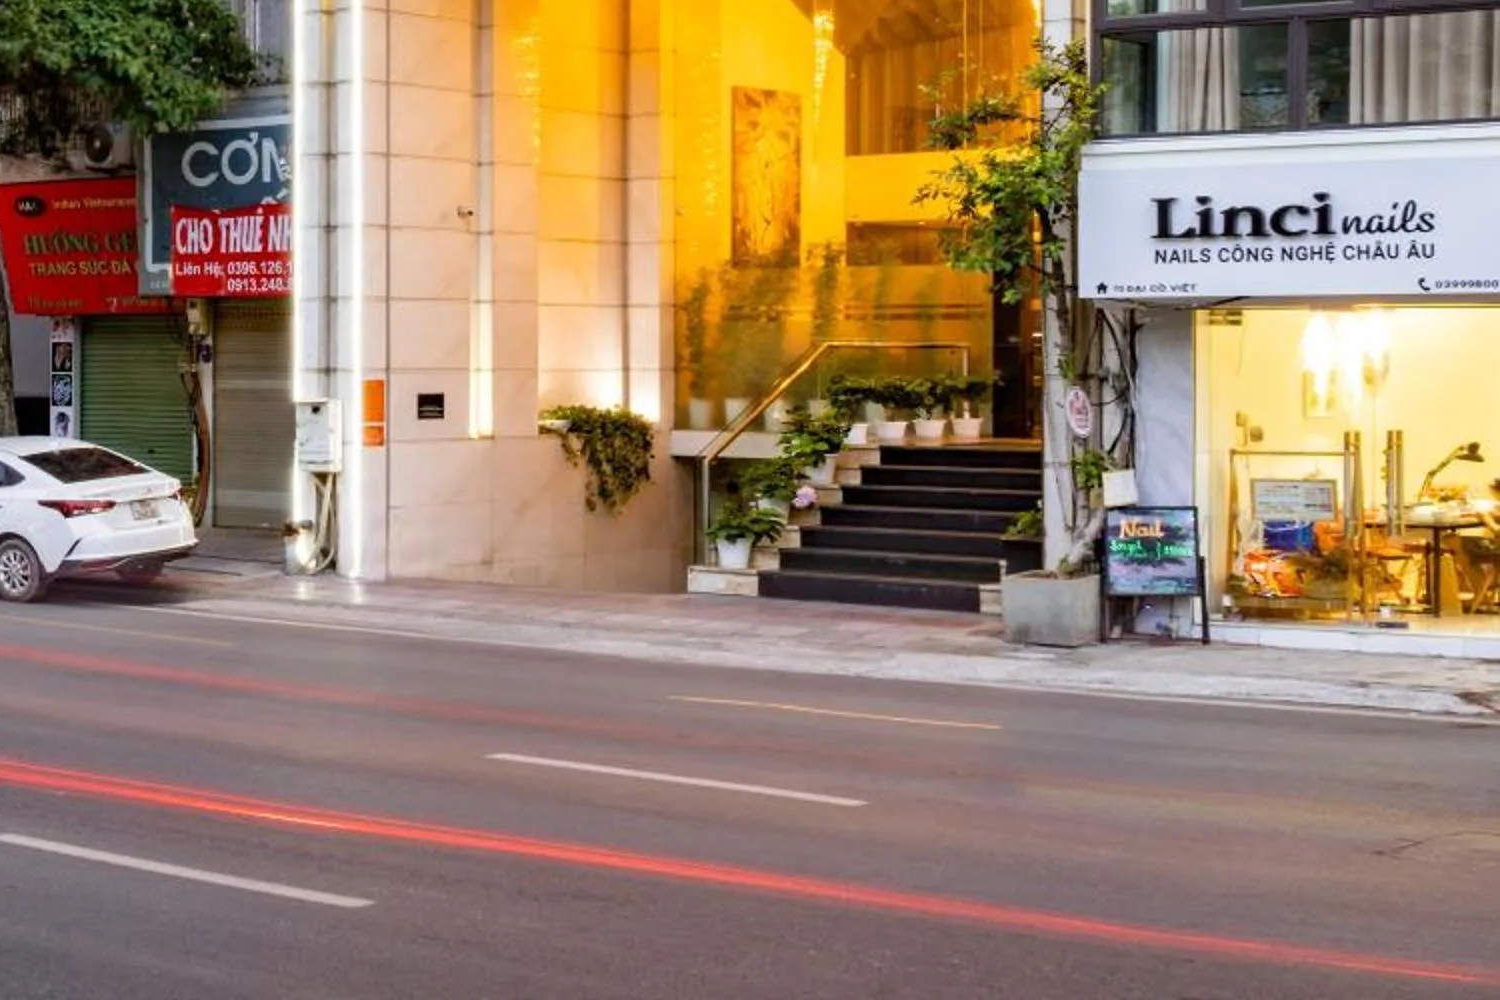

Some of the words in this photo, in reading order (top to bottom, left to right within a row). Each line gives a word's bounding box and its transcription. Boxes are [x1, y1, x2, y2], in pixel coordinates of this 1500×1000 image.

[1150, 192, 1337, 240] Linci
[1341, 199, 1436, 236] nails
[175, 217, 214, 255] CHO
[218, 206, 266, 254] THUÊ
[1154, 248, 1212, 265] NAILS
[1217, 244, 1273, 263] CÔNG
[1280, 242, 1336, 264] NGHỆ
[1342, 240, 1400, 261] CHÂU
[1406, 240, 1436, 260] ÂU
[28, 259, 77, 277] TRANG
[175, 261, 201, 276] Liên
